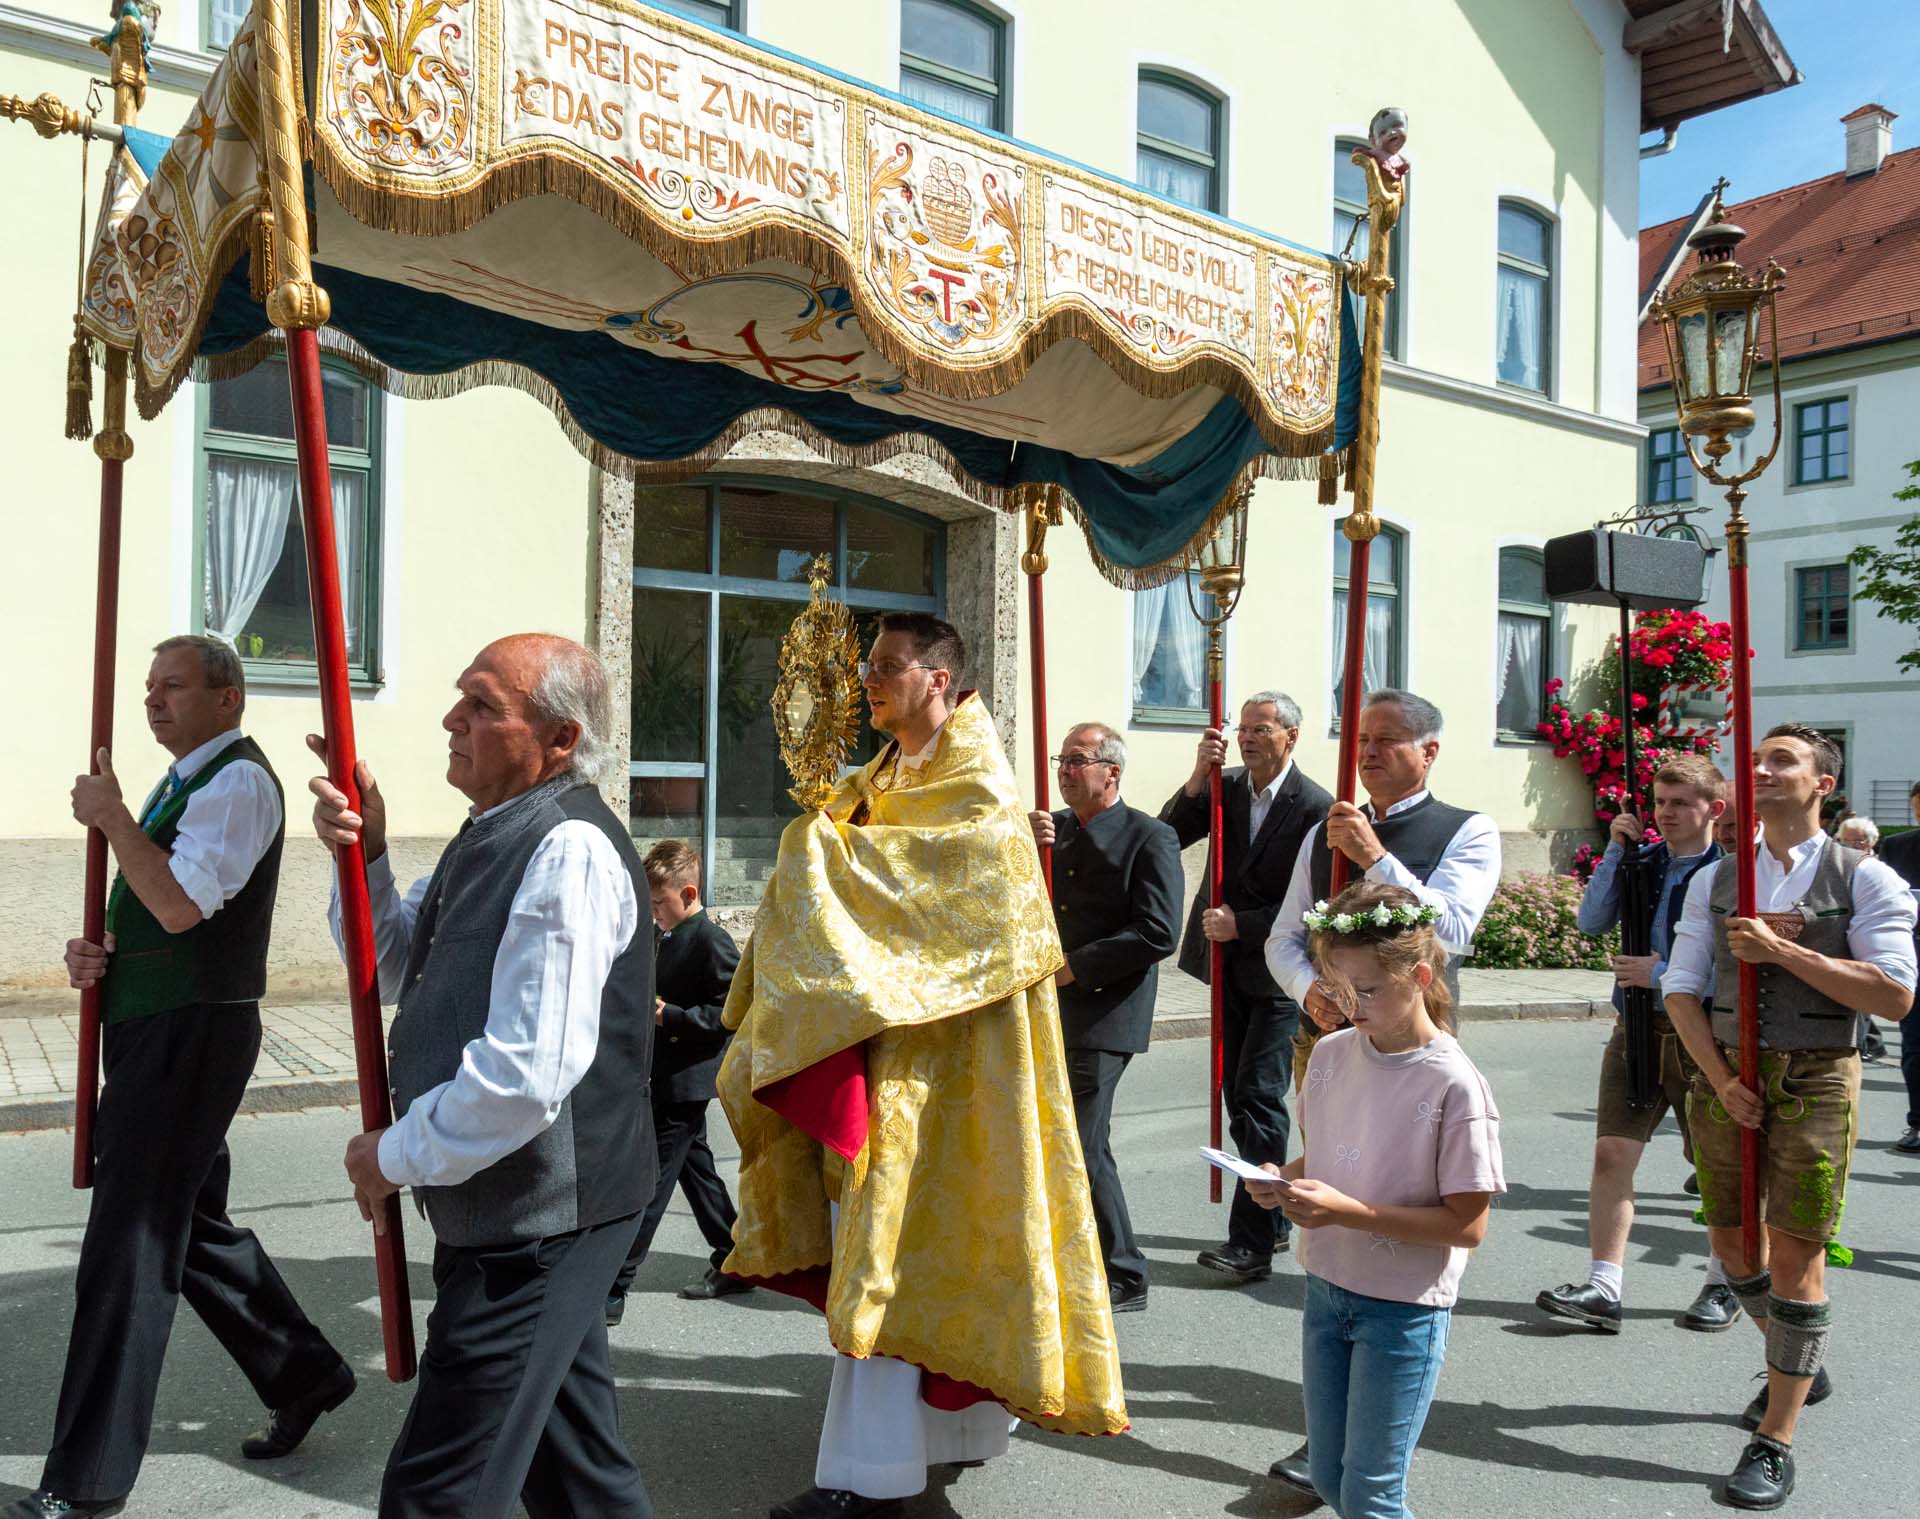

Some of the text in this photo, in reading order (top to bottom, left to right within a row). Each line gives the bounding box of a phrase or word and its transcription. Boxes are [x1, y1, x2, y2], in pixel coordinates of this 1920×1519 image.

[545, 18, 679, 103] PREISE
[552, 81, 809, 200] DAS GEHEIMNIS
[1060, 202, 1133, 257] DIESES
[1200, 255, 1244, 295] VOLL
[1076, 252, 1228, 332] HERRLICHKEIT
